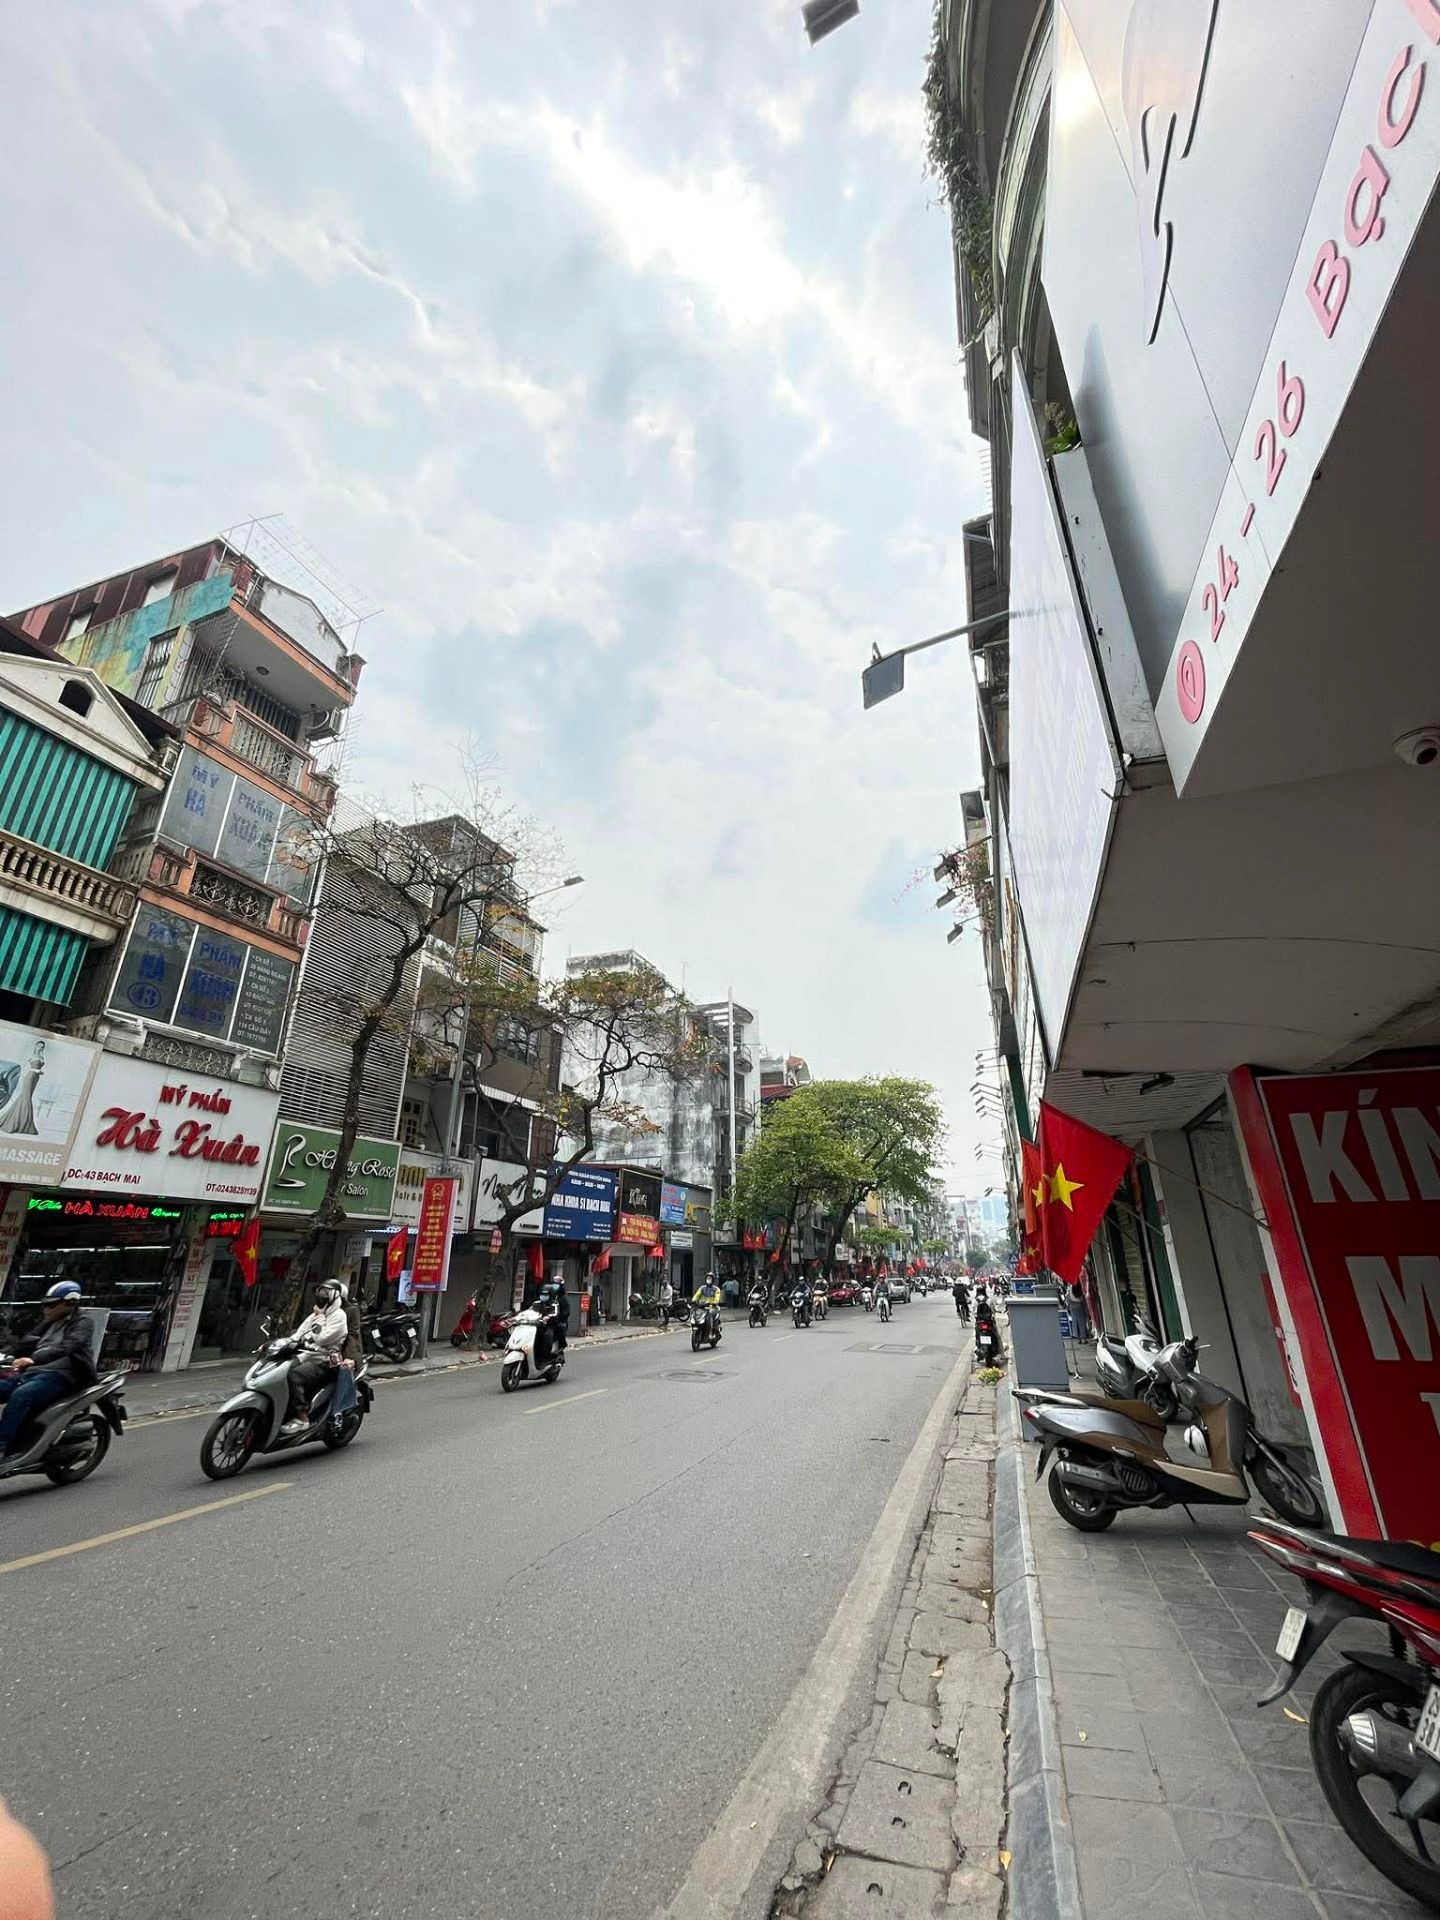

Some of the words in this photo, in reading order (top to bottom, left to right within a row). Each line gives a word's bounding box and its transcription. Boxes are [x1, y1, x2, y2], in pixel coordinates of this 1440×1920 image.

[1202, 545, 1239, 643] 24
[1254, 360, 1305, 497] 26
[96, 1107, 163, 1151] Hà
[169, 1119, 260, 1167] Xuân
[97, 1171, 121, 1184] BẠCH
[124, 1174, 141, 1185] MAI
[361, 1158, 397, 1179] Rose
[346, 1183, 369, 1197] Salon
[64, 1200, 94, 1215] HÀ
[96, 1203, 150, 1219] XUÂN
